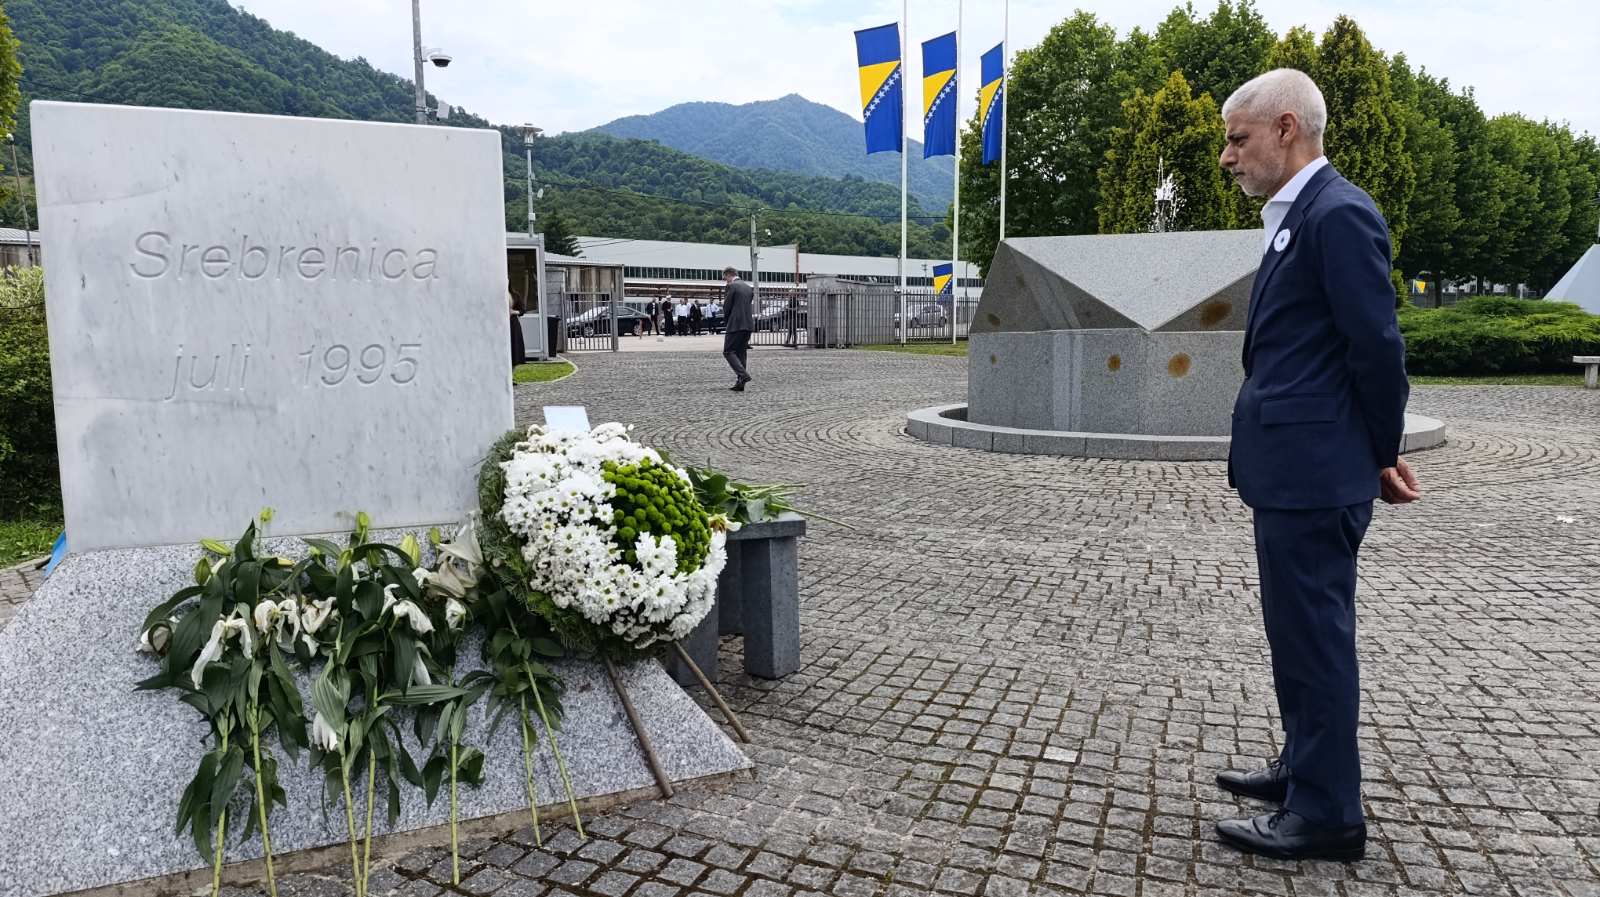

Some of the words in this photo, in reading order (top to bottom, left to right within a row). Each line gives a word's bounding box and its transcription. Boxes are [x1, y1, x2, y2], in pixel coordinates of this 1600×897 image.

[129, 231, 439, 282] Srebrenica
[164, 343, 253, 402] juli
[299, 342, 422, 388] 1995
